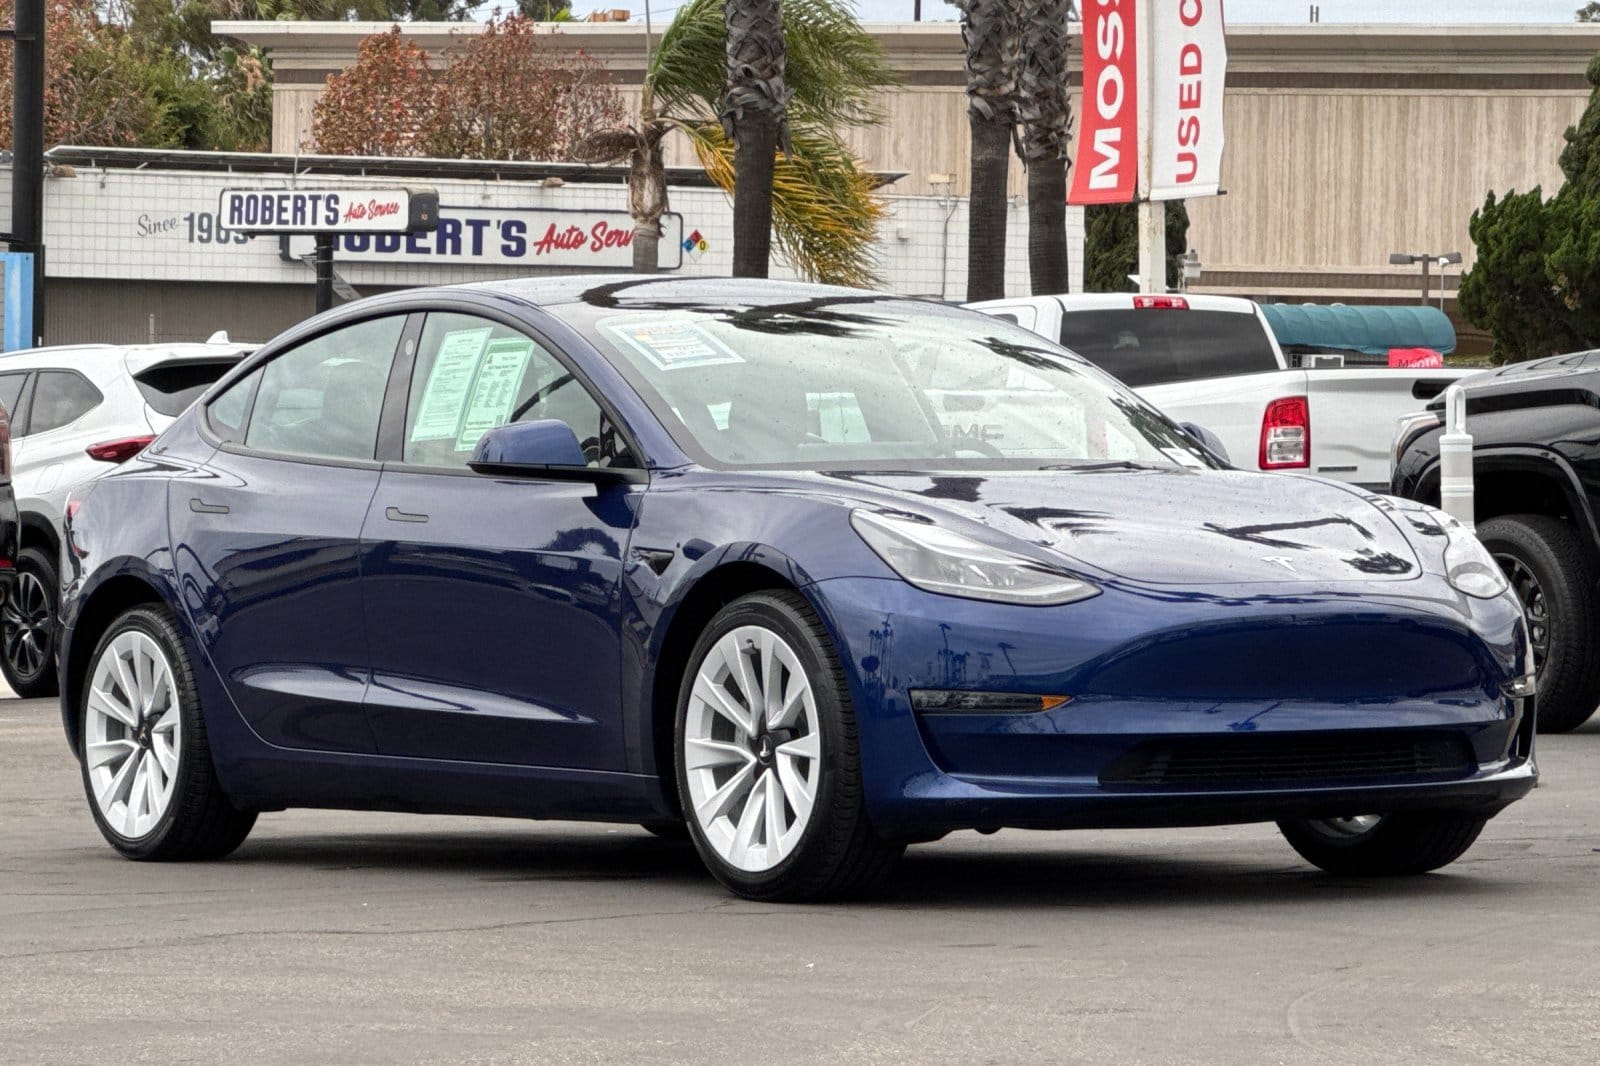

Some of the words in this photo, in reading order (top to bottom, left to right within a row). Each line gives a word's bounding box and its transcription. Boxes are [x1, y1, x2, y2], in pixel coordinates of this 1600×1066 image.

[1088, 0, 1125, 190] MOS
[1175, 43, 1203, 184] USED
[136, 213, 178, 238] Since
[229, 193, 340, 226] ROBERT'S
[343, 200, 367, 224] Auto
[367, 198, 400, 221] Service
[533, 222, 588, 256] Auto
[590, 220, 635, 252] Serv
